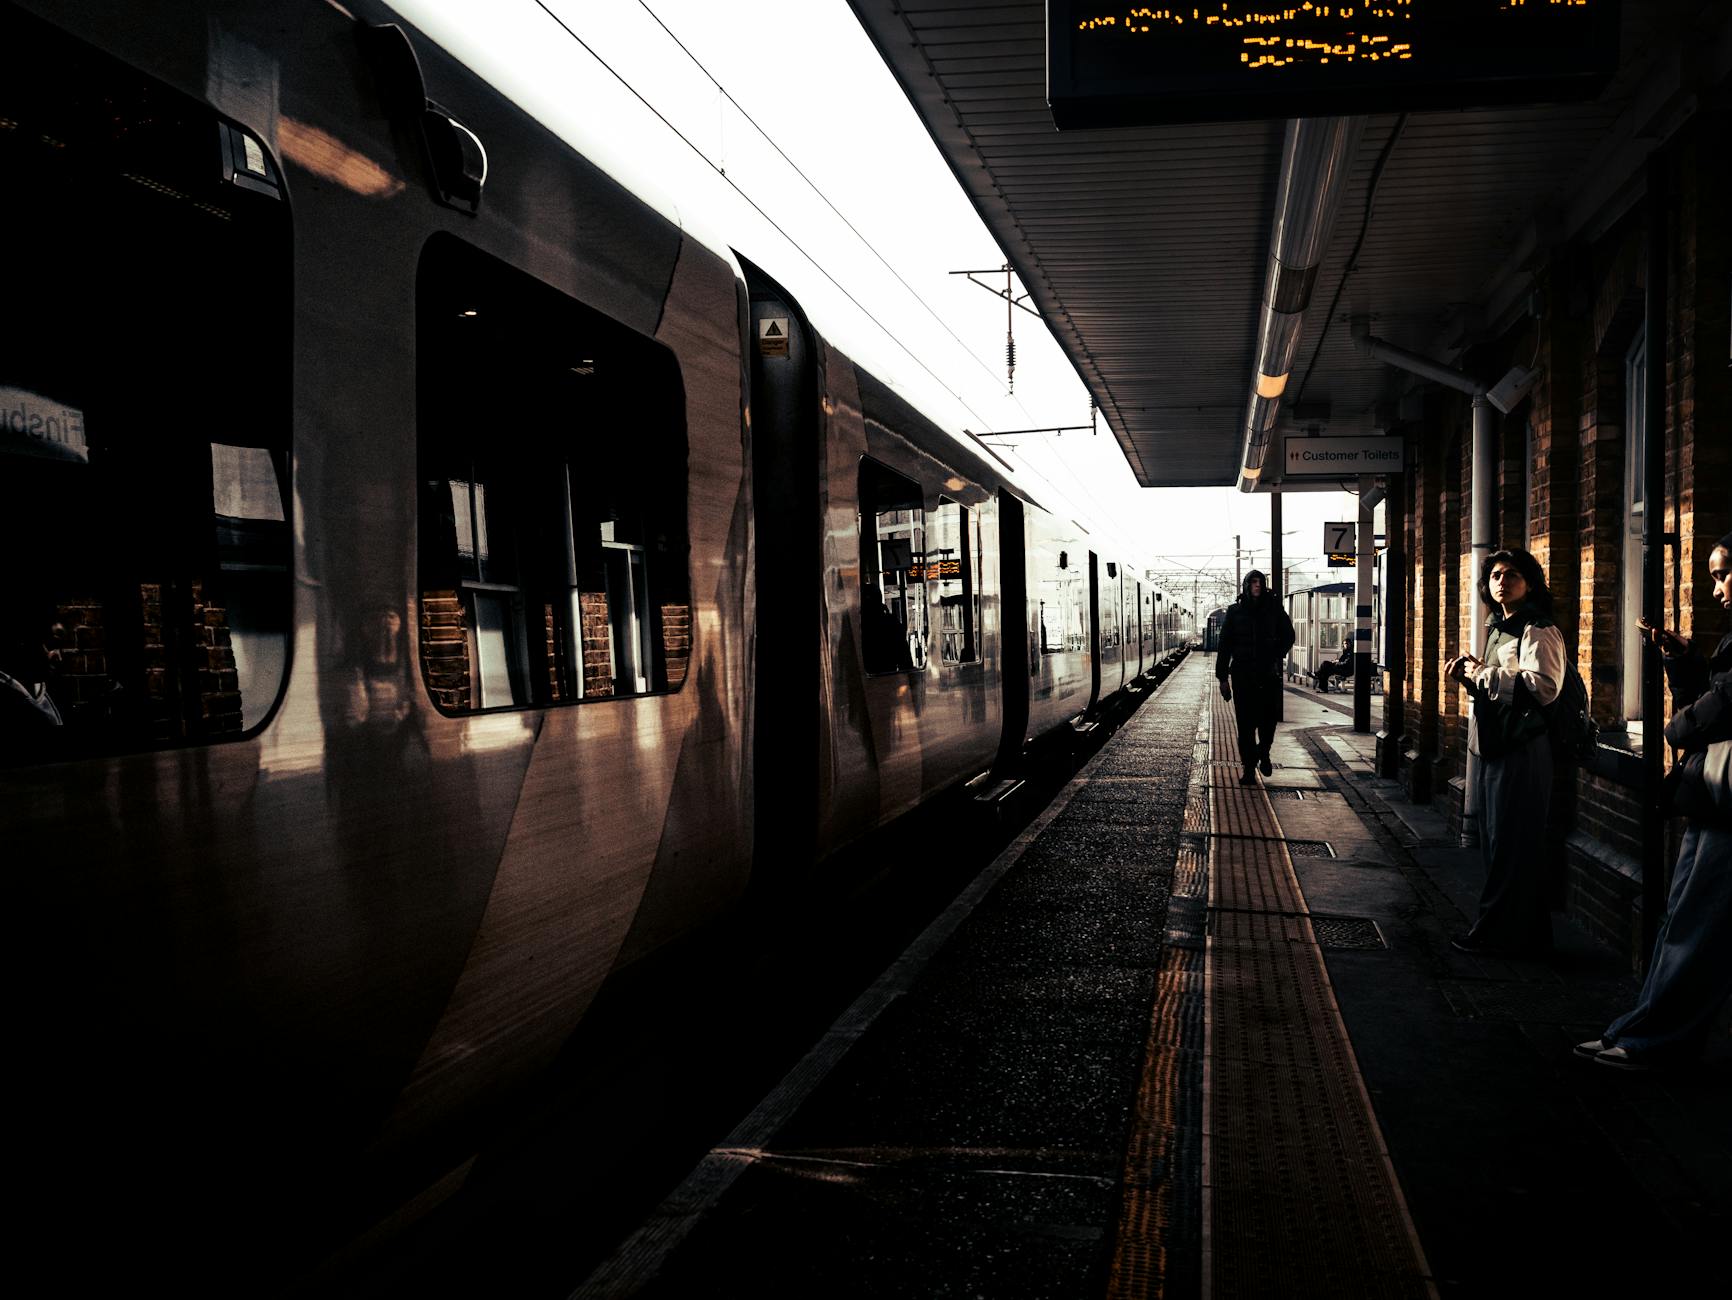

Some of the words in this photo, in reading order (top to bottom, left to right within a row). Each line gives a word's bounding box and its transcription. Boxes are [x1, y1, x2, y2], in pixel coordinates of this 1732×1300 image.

[1302, 450, 1359, 461] Customer
[1362, 450, 1400, 460] Toilets
[1332, 527, 1348, 550] 7
